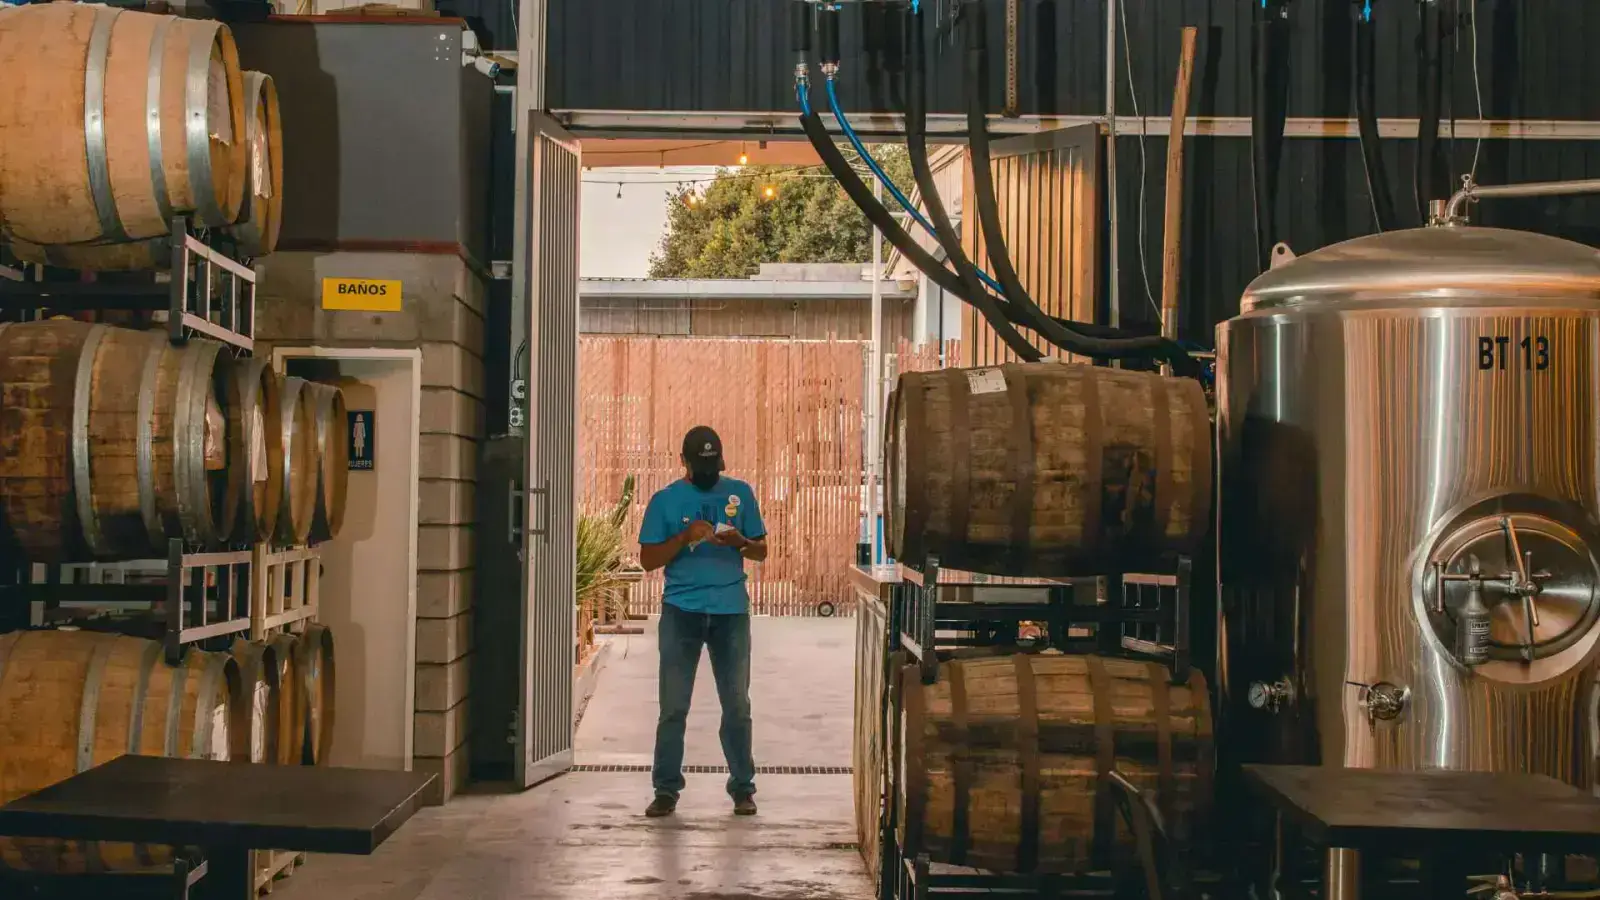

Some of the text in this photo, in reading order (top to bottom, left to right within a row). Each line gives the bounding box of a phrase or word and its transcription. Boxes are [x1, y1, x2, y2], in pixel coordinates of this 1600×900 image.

[338, 281, 387, 295] BAÑOS
[1478, 336, 1549, 370] BT 13
